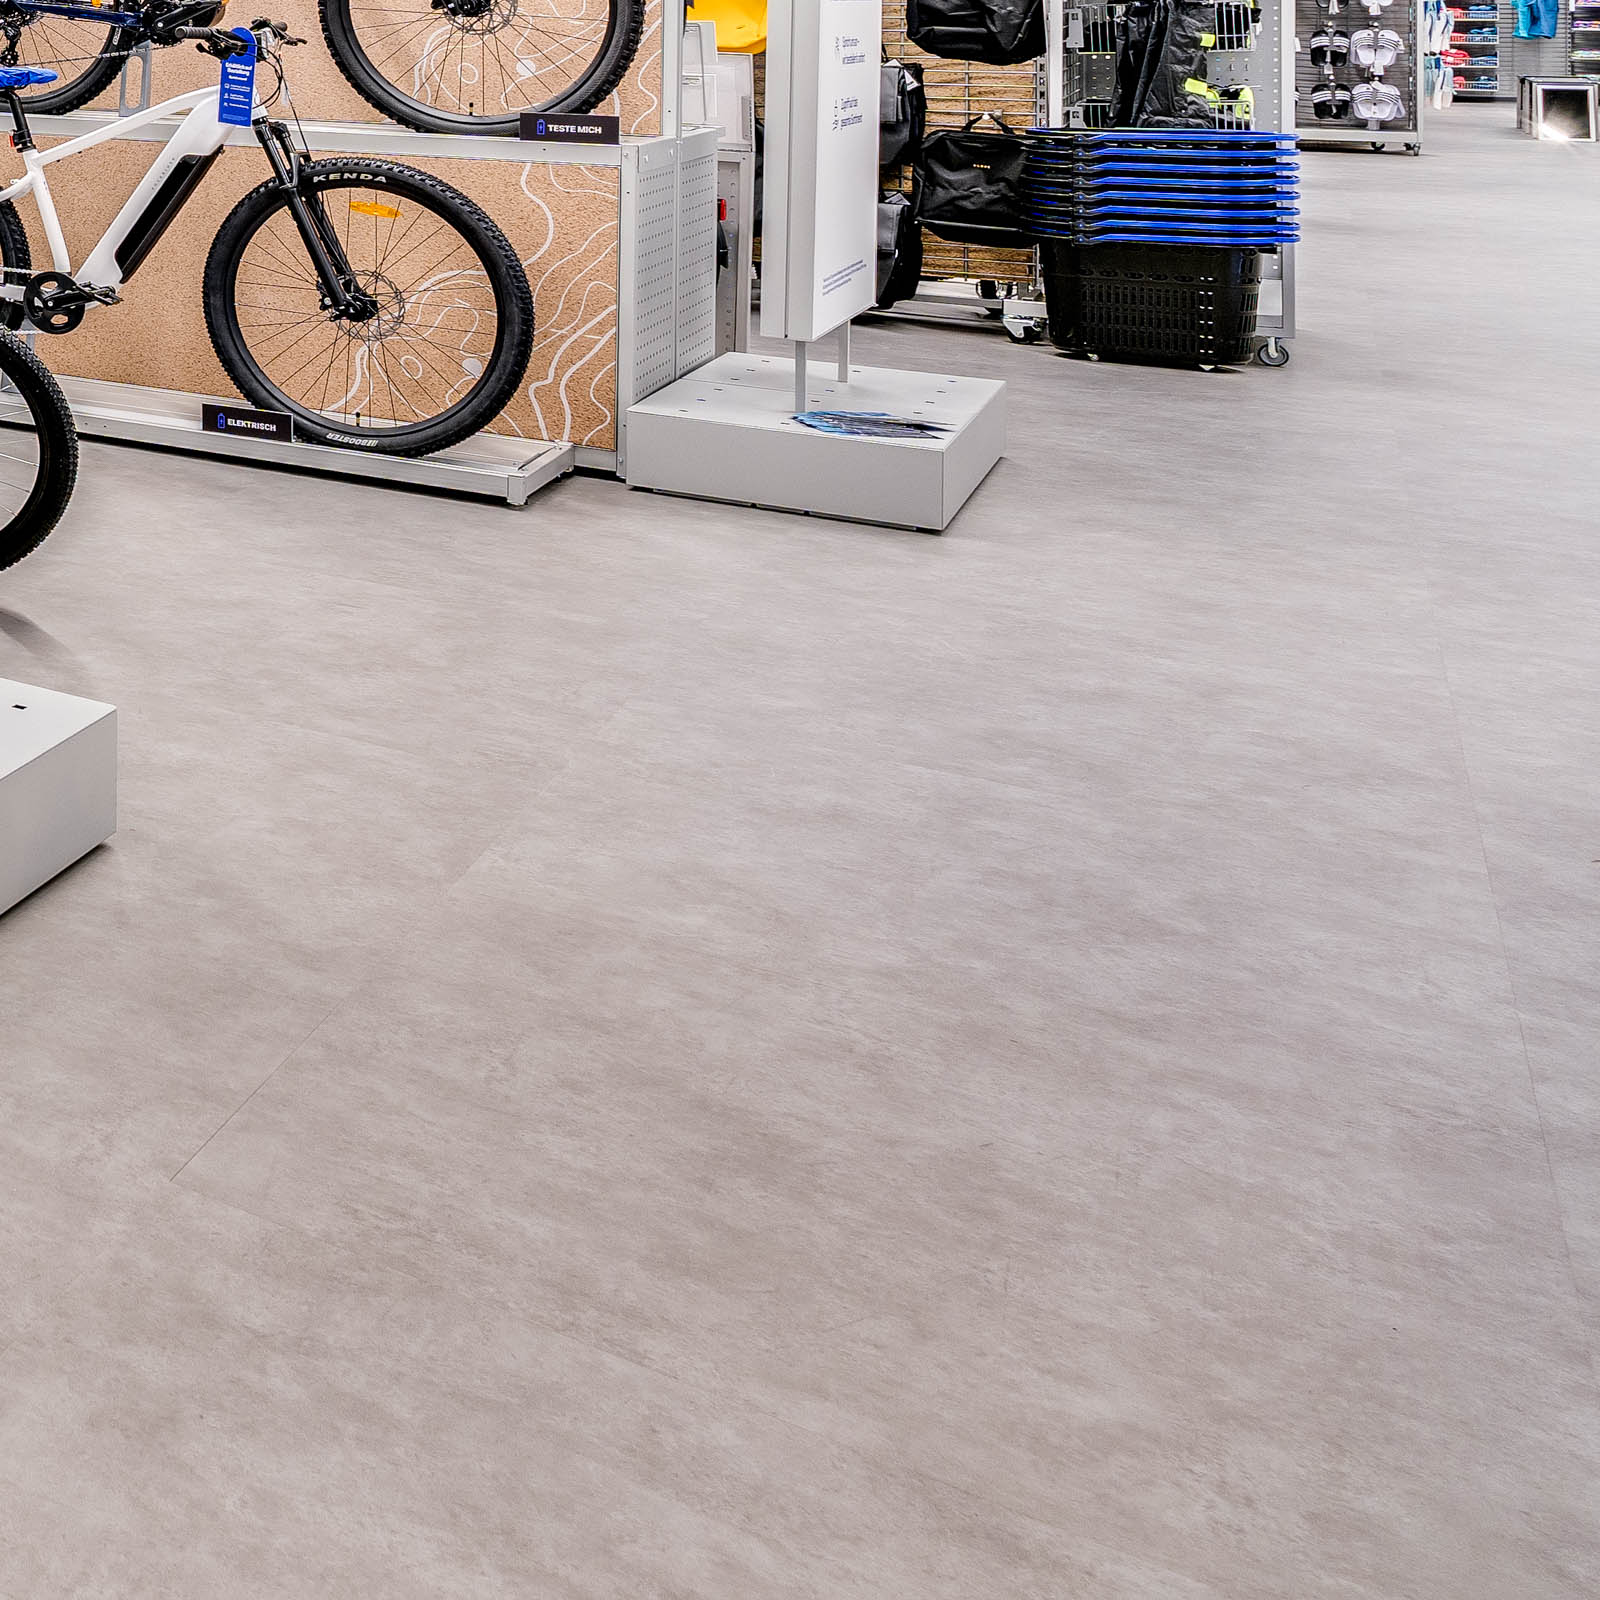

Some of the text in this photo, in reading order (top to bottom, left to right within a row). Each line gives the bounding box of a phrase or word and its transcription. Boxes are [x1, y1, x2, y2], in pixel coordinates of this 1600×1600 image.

[547, 124, 602, 134] TESTE MICH
[313, 172, 387, 183] KENDA
[227, 418, 277, 432] ELEKTRISCH
